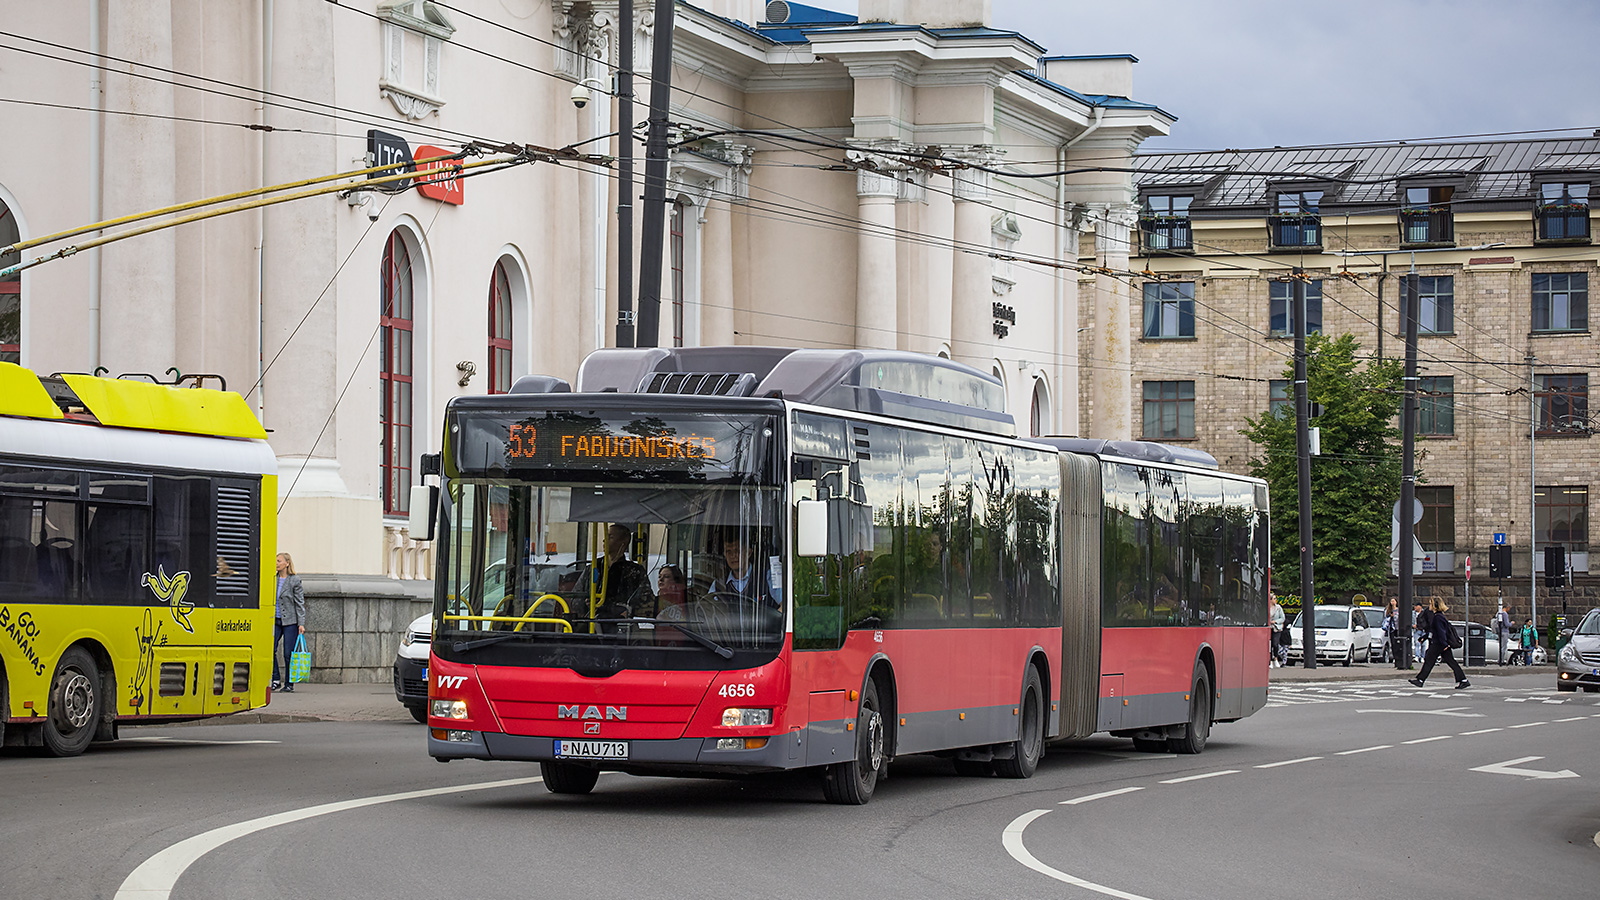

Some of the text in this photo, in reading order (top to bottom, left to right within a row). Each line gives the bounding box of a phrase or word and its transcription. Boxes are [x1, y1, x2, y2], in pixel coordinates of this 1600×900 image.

[427, 160, 460, 193] LINK
[509, 425, 716, 459] 53 FABIJONIŠKĖS
[1496, 534, 1503, 543] J
[18, 611, 40, 642] GO!
[216, 619, 252, 633] @karkarledai
[0, 606, 46, 676] BANANAS
[718, 684, 755, 698] 4656
[558, 704, 628, 721] MAN
